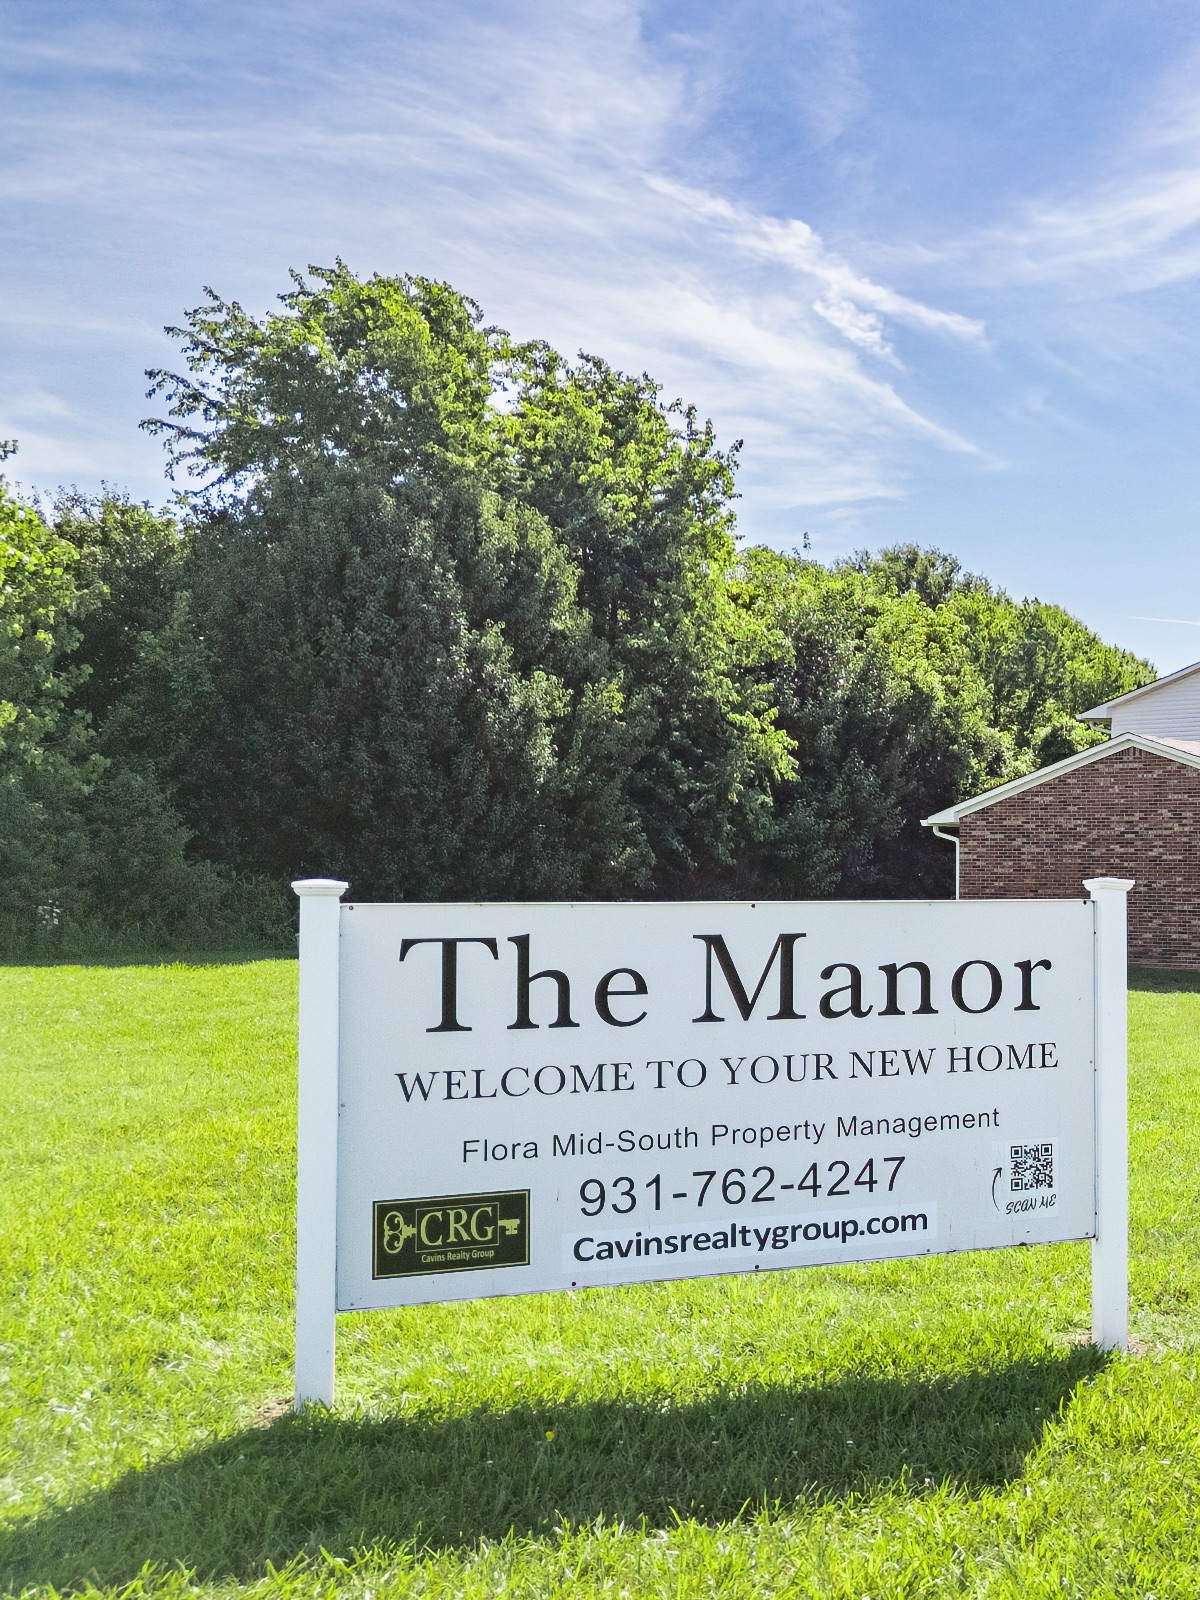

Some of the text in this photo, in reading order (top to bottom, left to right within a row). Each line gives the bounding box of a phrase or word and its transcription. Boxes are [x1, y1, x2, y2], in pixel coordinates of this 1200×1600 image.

[399, 933, 1051, 1032] The Manor
[395, 1043, 1058, 1102] WELCOME TO YOUR NEW HOME
[463, 1108, 1000, 1162] Flora Mid-South Property Management
[579, 1156, 906, 1217] 931-762-4247
[1005, 1194, 1057, 1215] SCAN ME
[420, 1206, 495, 1246] CRG
[573, 1210, 928, 1263] Cavinsrealtygroup.com
[421, 1249, 495, 1263] Cavins Realty Group
